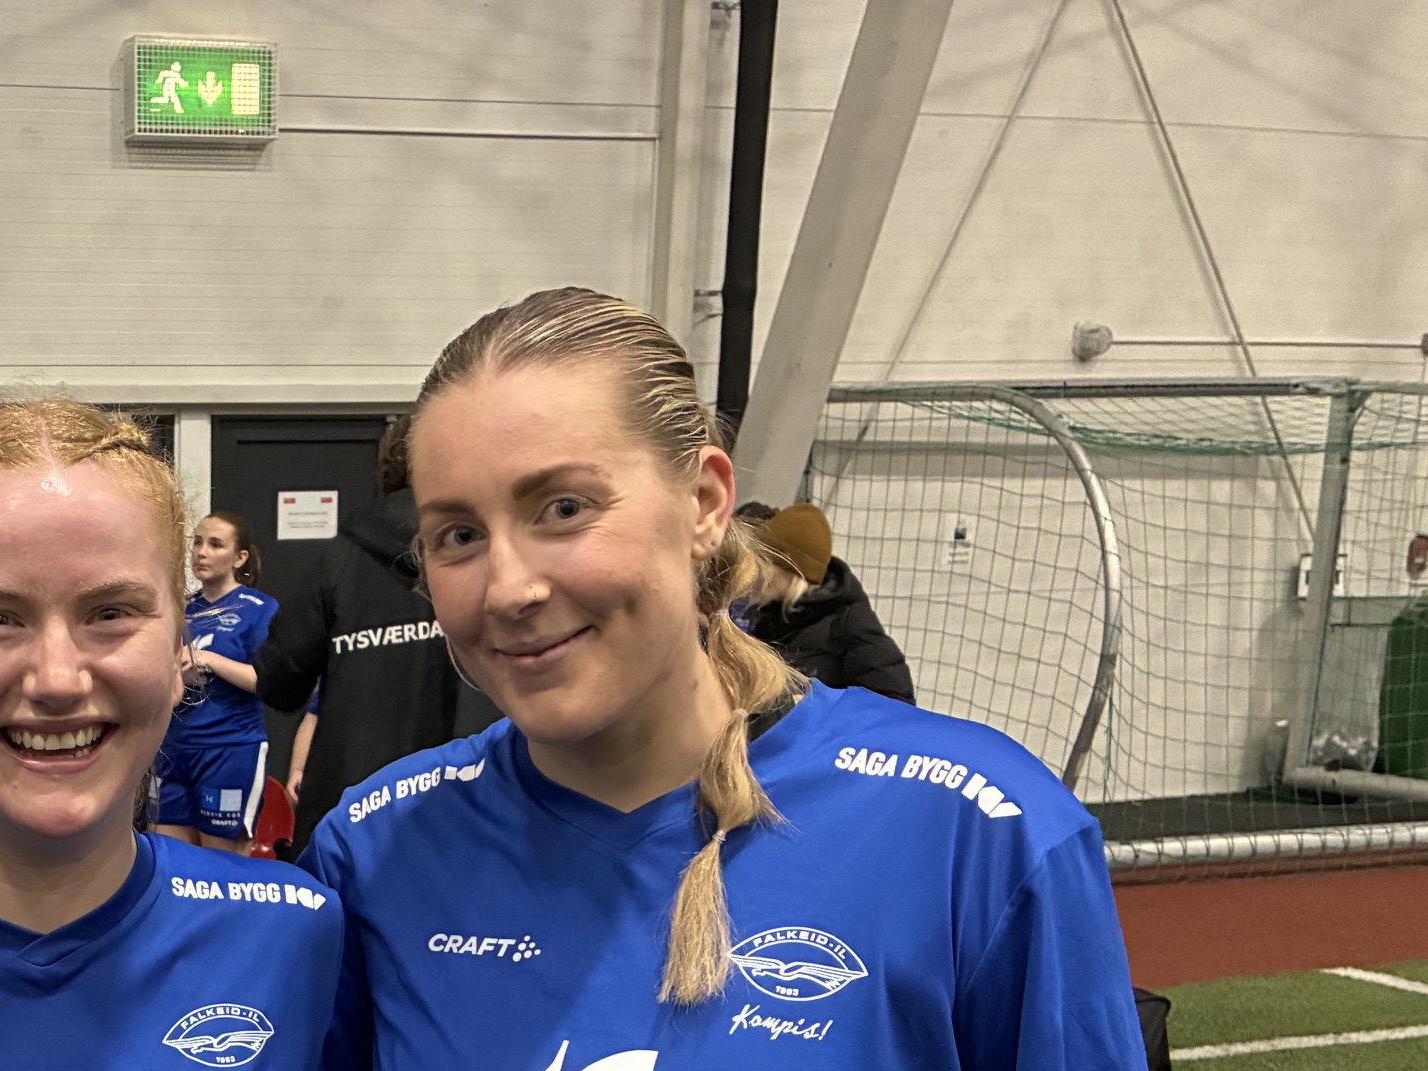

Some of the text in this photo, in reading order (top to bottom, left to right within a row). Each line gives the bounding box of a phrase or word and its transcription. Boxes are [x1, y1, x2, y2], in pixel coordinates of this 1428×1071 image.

[332, 620, 444, 654] TYSVÆRDA
[834, 747, 969, 790] SAGA BYGG
[349, 766, 441, 823] SAGA BYGG
[171, 876, 281, 903] SAGA BYGG
[428, 933, 517, 957] CRAFT
[729, 1003, 834, 1040] Kompis!
